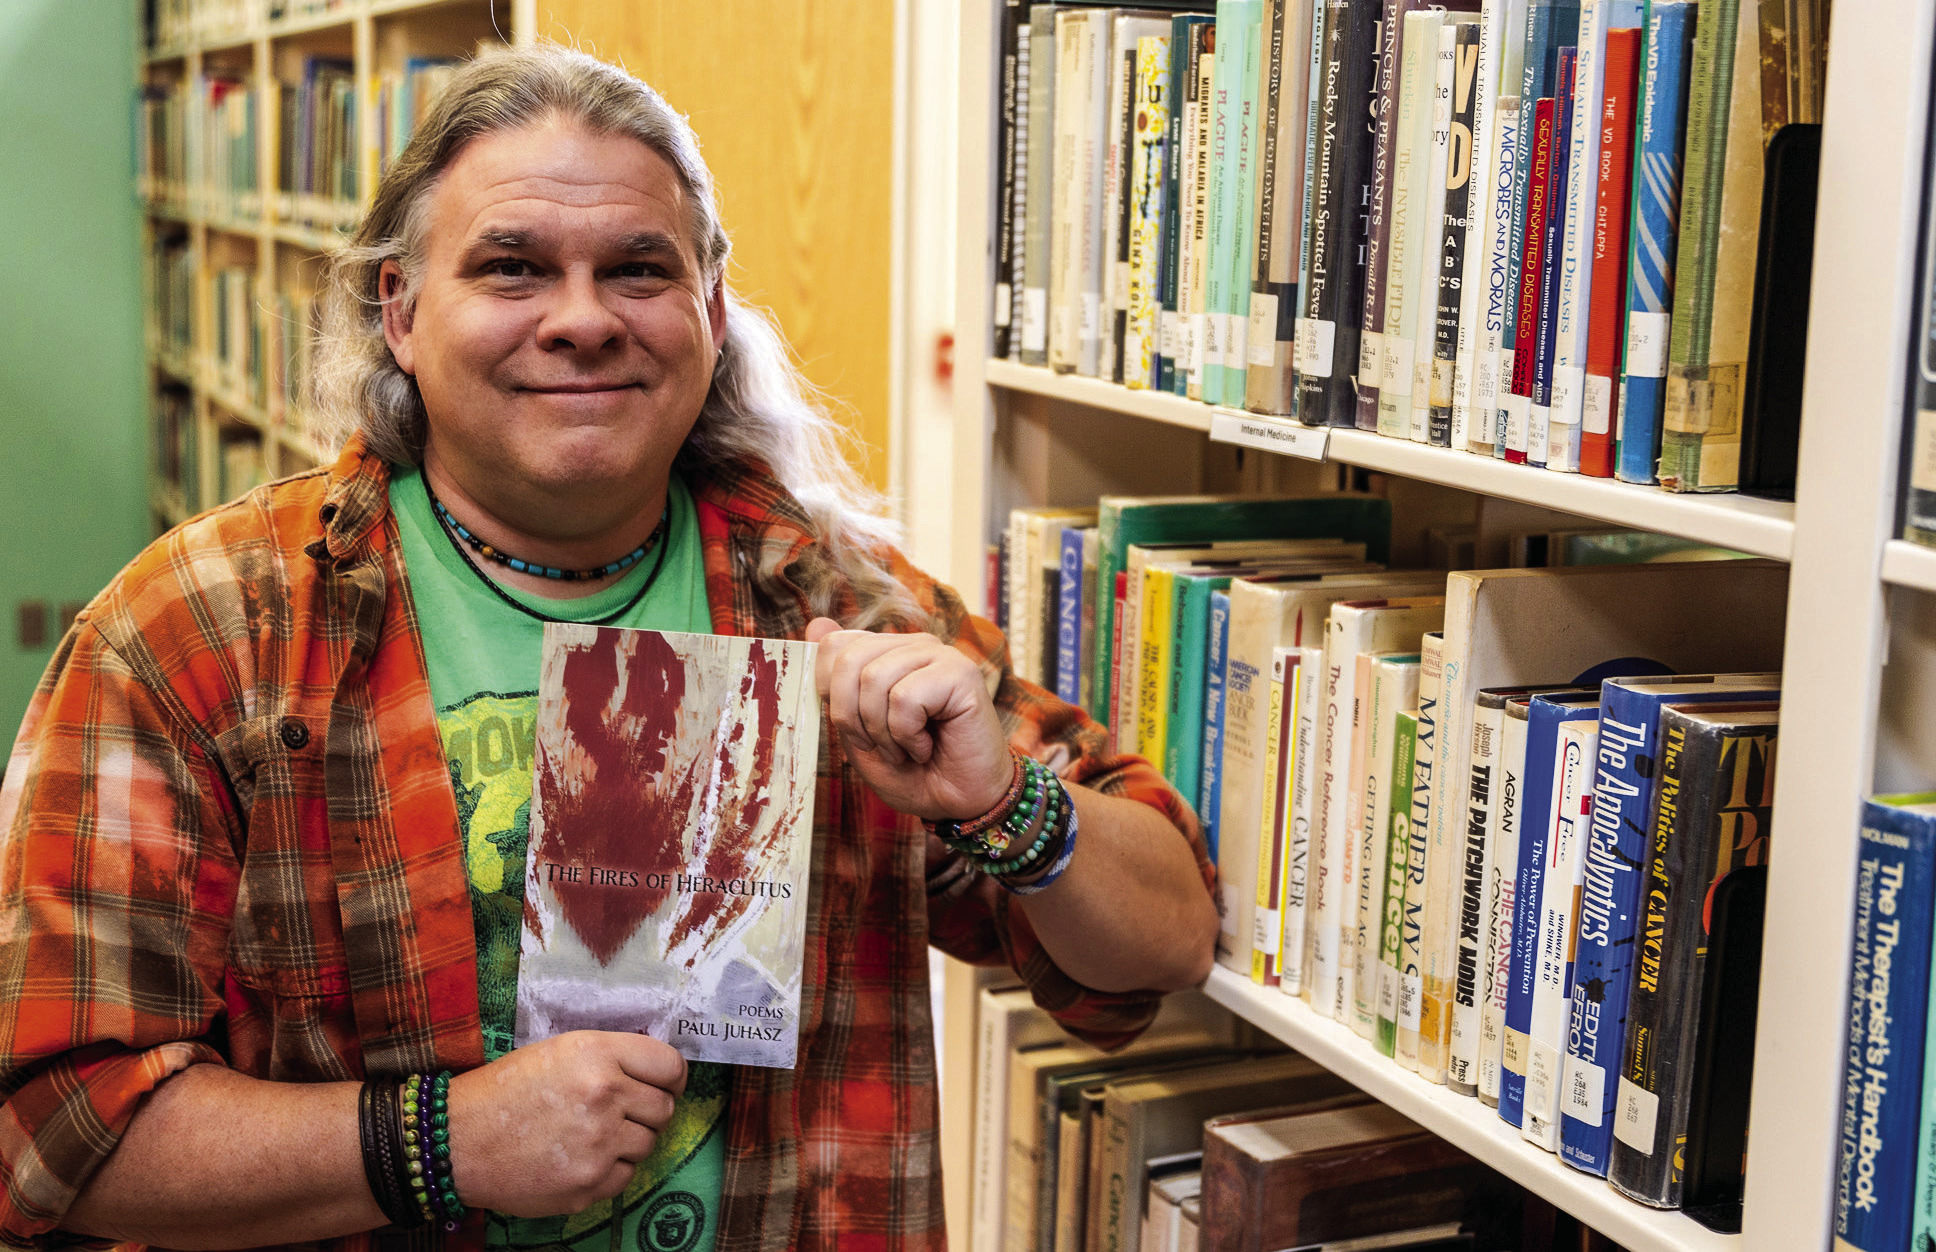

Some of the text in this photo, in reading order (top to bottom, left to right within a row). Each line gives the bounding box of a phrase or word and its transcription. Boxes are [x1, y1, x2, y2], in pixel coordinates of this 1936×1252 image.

[1313, 7, 1322, 65] ENGLISH
[1381, 4, 1398, 91] PRINCES
[1379, 95, 1393, 116] &
[1402, 50, 1417, 121] Shurkin
[1466, 8, 1490, 232] SEXUALLY TRANSMITTED DISEASES
[1195, 77, 1210, 241] MIGRANTS AND MALARIA IN AFRICA
[1214, 89, 1228, 162] PLAGUE
[1238, 101, 1251, 174] PLAGUE
[1259, 29, 1282, 261] HISTORY OF POLIOMYELITIS
[1303, 100, 1318, 219] RHEUMATIC FEVER IN AMERICA
[1535, 118, 1551, 179] SEXUALLY
[1310, 60, 1341, 320] Rocky Mountain Spotted Fever
[1372, 121, 1389, 225] PEASANTS
[1505, 4, 1537, 327] Rinear The Sexually Transmitted Diseases
[1560, 4, 1594, 334] THE SEXUALLY TRANSMITTED DISEASES
[1595, 97, 1617, 260] THE VD BOOK CHIAPPA
[1389, 188, 1408, 279] INVISIBLE
[1444, 213, 1467, 228] The
[1445, 235, 1457, 248] A
[1486, 125, 1516, 331] MICROBES AND MORALS
[1526, 184, 1545, 270] TRANSMITTED
[1535, 55, 1569, 403] Daniels Hillman Barton Goldmeier Sexually Transmitted Diseases and AIDS
[1130, 229, 1142, 333] GINA KOLAT
[1367, 240, 1379, 293] Donald
[1445, 256, 1456, 268] B
[1385, 283, 1403, 336] FIRE
[1519, 273, 1535, 339] DISEASES
[1240, 424, 1297, 443] Internal Medicine
[1058, 546, 1078, 696] CANCER
[1205, 687, 1222, 723] New
[1267, 690, 1281, 756] CANCER
[1416, 696, 1437, 752] MY
[1472, 721, 1483, 755] Hixson
[1480, 723, 1495, 758] Joseph
[1200, 725, 1219, 828] Breakthrough
[1316, 665, 1342, 912] The Cancer Reference Book
[1435, 661, 1460, 847] The nurse and the cancer patient
[1470, 764, 1491, 806] THE
[1289, 716, 1312, 908] Understanding CANCER
[1502, 770, 1517, 834] AGRAN
[1558, 741, 1582, 863] Cancer Free
[1580, 717, 1647, 947] The Apocalyptics
[545, 863, 793, 900] THE FIRES OF HERACLITUS
[1358, 776, 1377, 915] GETTING WELL
[1460, 806, 1488, 944] PATCHWORK
[1520, 868, 1530, 895] Oliver
[1639, 727, 1687, 994] The Politics of CANCER
[1384, 811, 1410, 969] cancer
[1521, 840, 1545, 996] The Power of Prevention
[1878, 861, 1905, 915] The
[1403, 901, 1423, 956] MY
[1493, 878, 1516, 1011] THE CANCER
[1516, 937, 1525, 959] M.D.
[1542, 909, 1557, 983] and SHIKE, M.D.
[1553, 914, 1566, 962] WINAWER,
[739, 1004, 784, 1020] POEMS
[1455, 944, 1478, 1008] MOUS
[1864, 919, 1901, 1065] Therapist's
[678, 1018, 783, 1042] PAUL JUHASZ
[1580, 999, 1602, 1064] EDITH
[1634, 1025, 1648, 1068] Samuel
[1837, 857, 1880, 1234] Treatment Methods of Mental Disorders
[1457, 1060, 1470, 1083] Press
[1854, 1067, 1889, 1213] Handbook
